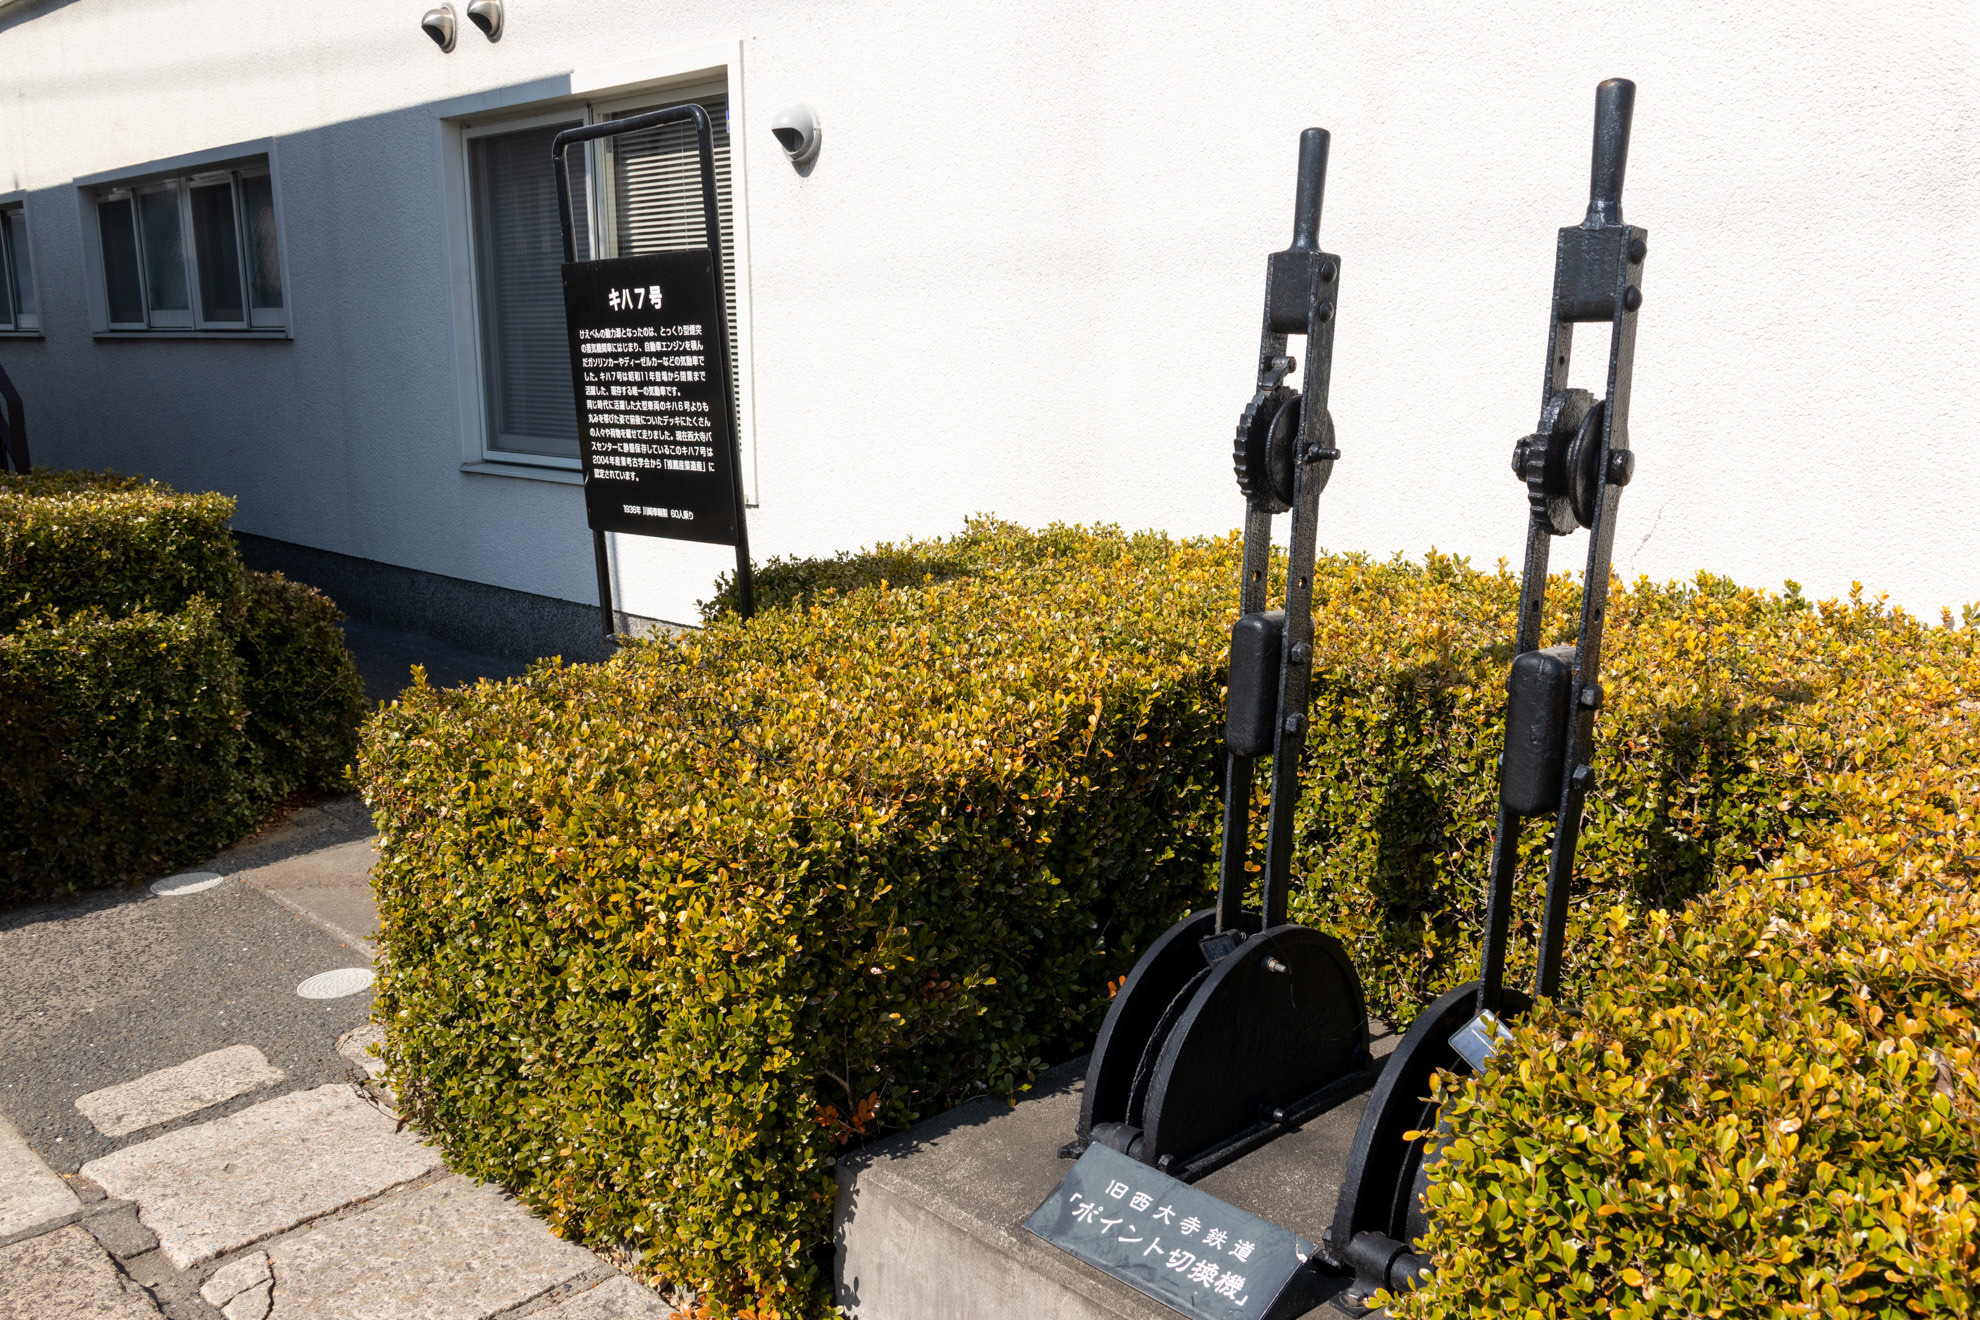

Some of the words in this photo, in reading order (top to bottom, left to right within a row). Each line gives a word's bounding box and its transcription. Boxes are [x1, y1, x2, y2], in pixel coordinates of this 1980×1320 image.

[593, 468, 640, 482] 認定されています。
[1069, 1192, 1249, 1306] 「ポイント切換機」
[1105, 1179, 1255, 1263] 旧西大寺鉄道
